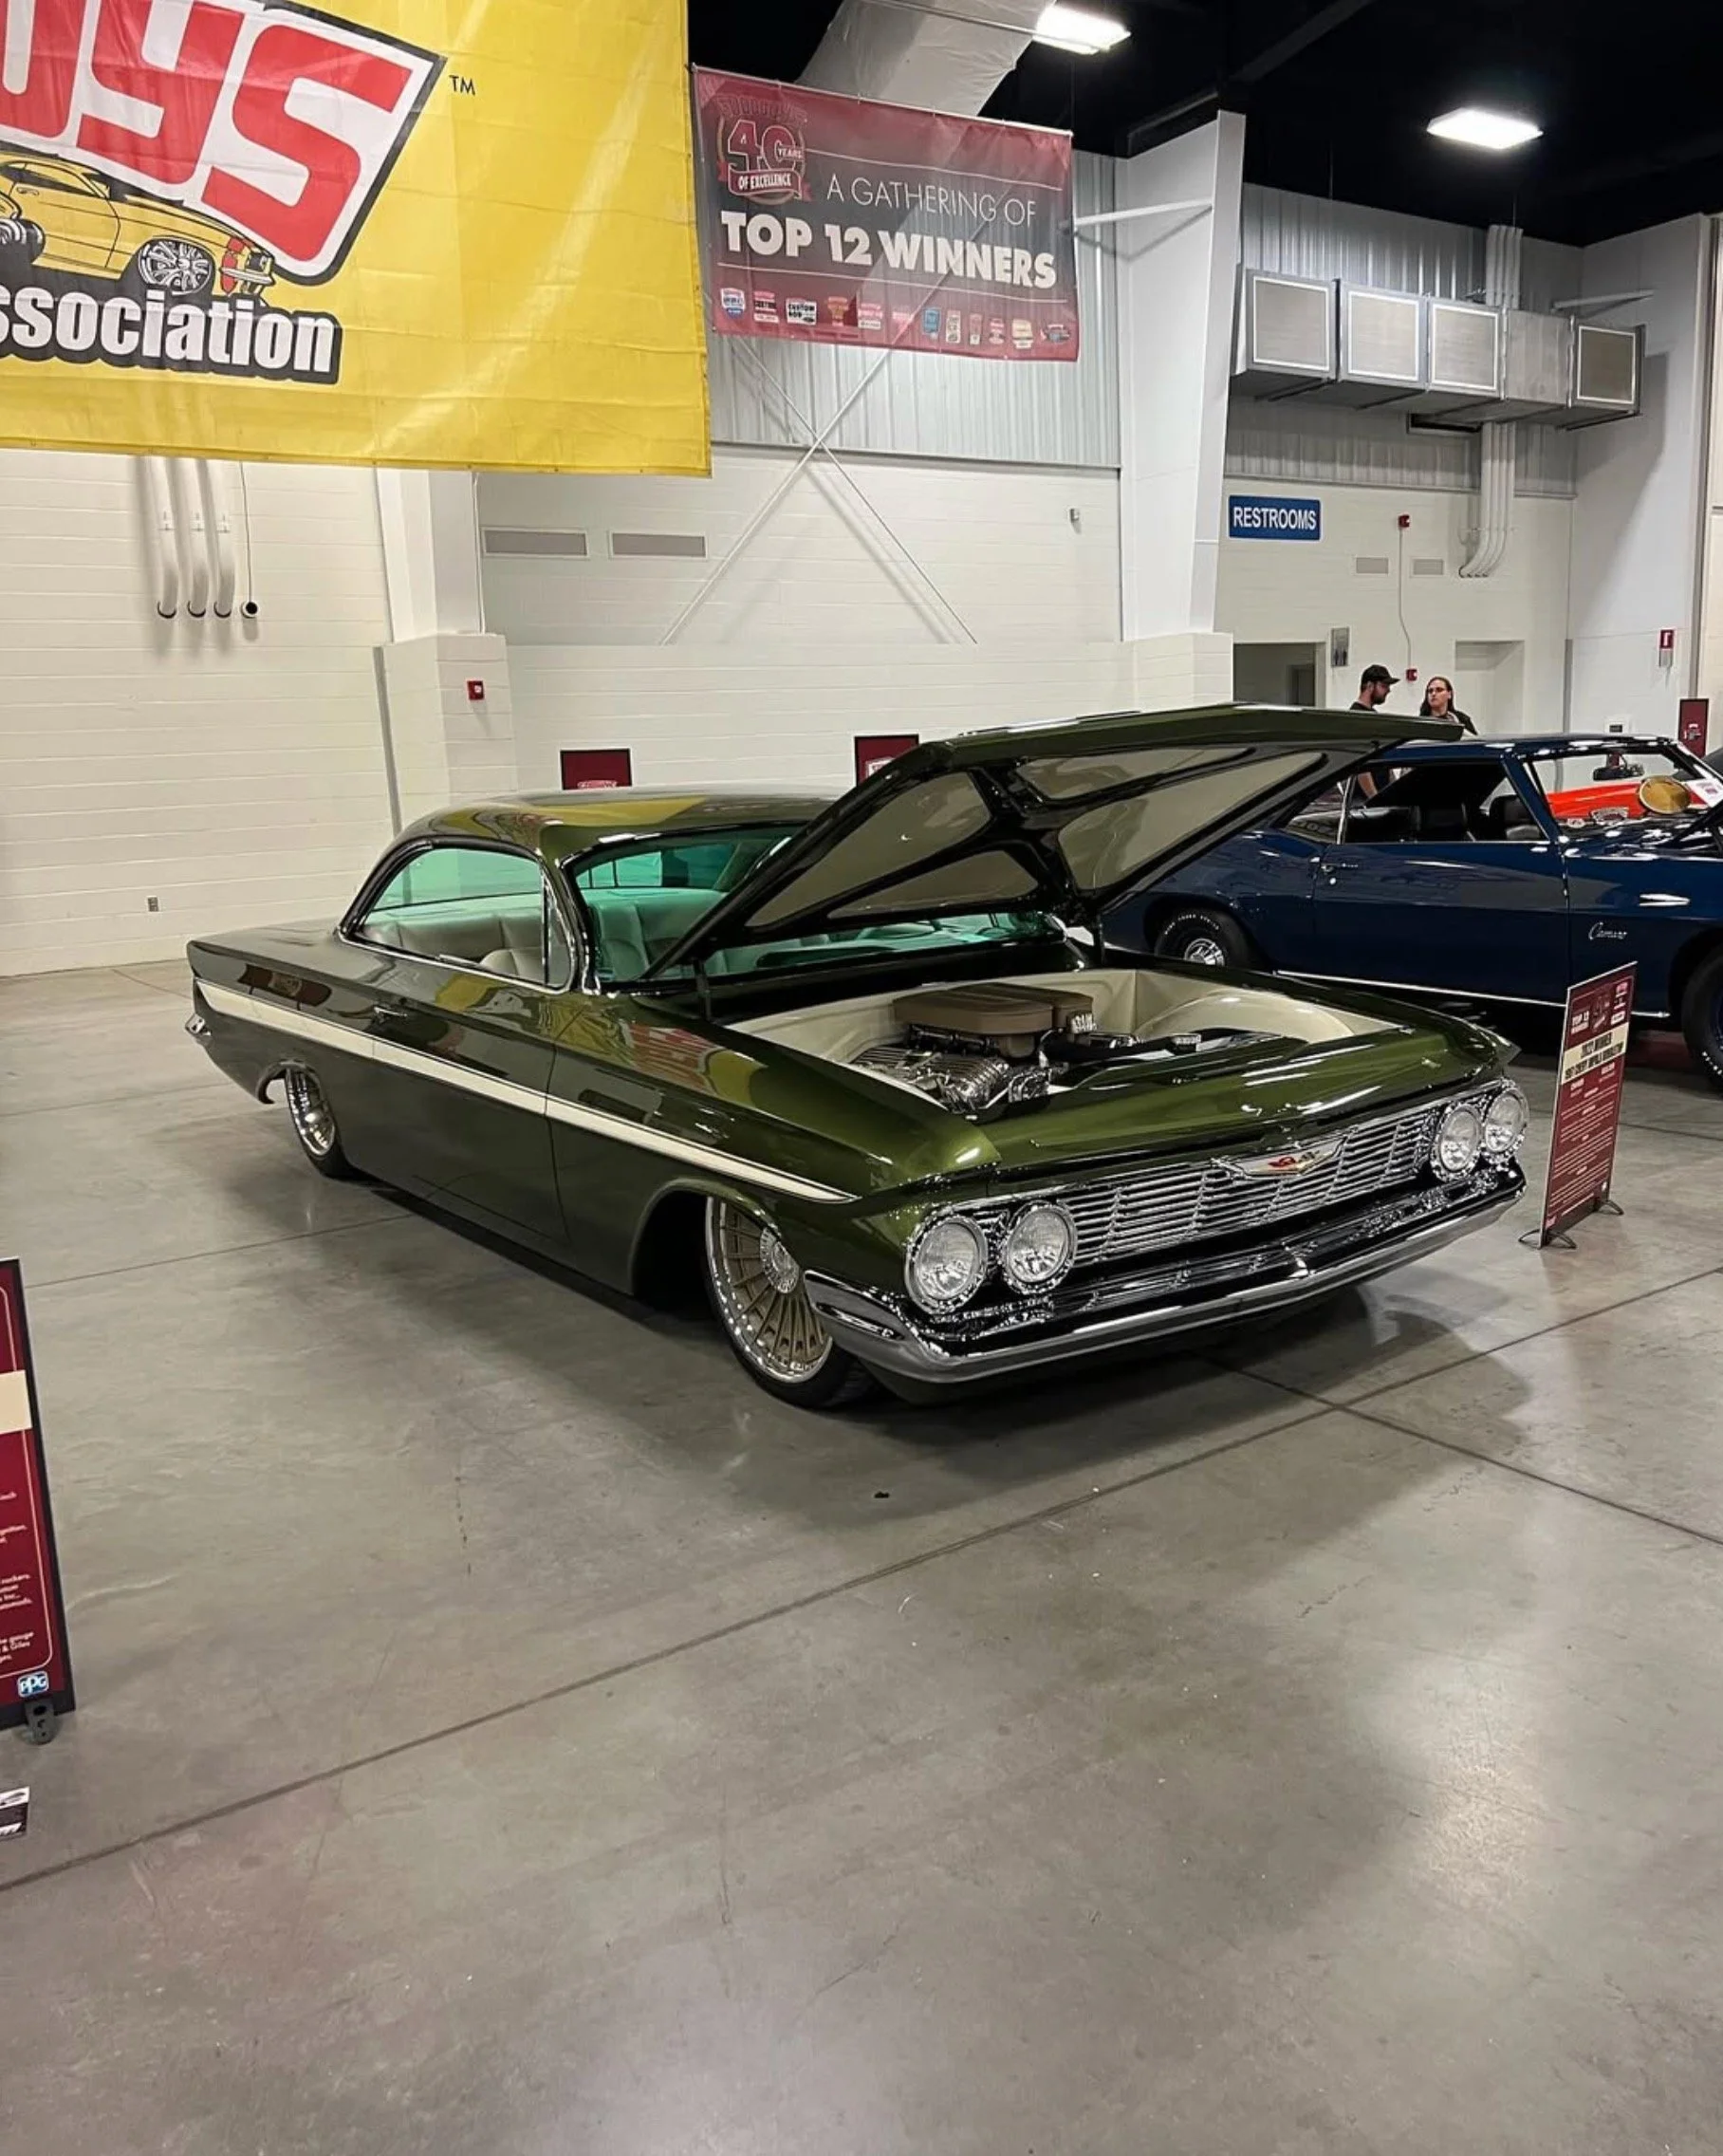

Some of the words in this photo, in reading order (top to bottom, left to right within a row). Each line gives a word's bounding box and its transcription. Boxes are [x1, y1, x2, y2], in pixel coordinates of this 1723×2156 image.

[449, 74, 476, 97] TM
[738, 175, 750, 191] OF
[750, 173, 792, 190] EXCELLENCE
[826, 173, 845, 203] A
[851, 177, 997, 222] GATHERING
[1004, 197, 1037, 229] OF
[720, 209, 813, 257] TOP
[824, 223, 873, 267] 12
[877, 229, 1058, 289] WINNERS
[0, 285, 336, 373] sociation
[1233, 506, 1318, 530] RESTROOMS
[20, 1675, 47, 1694] PPG
